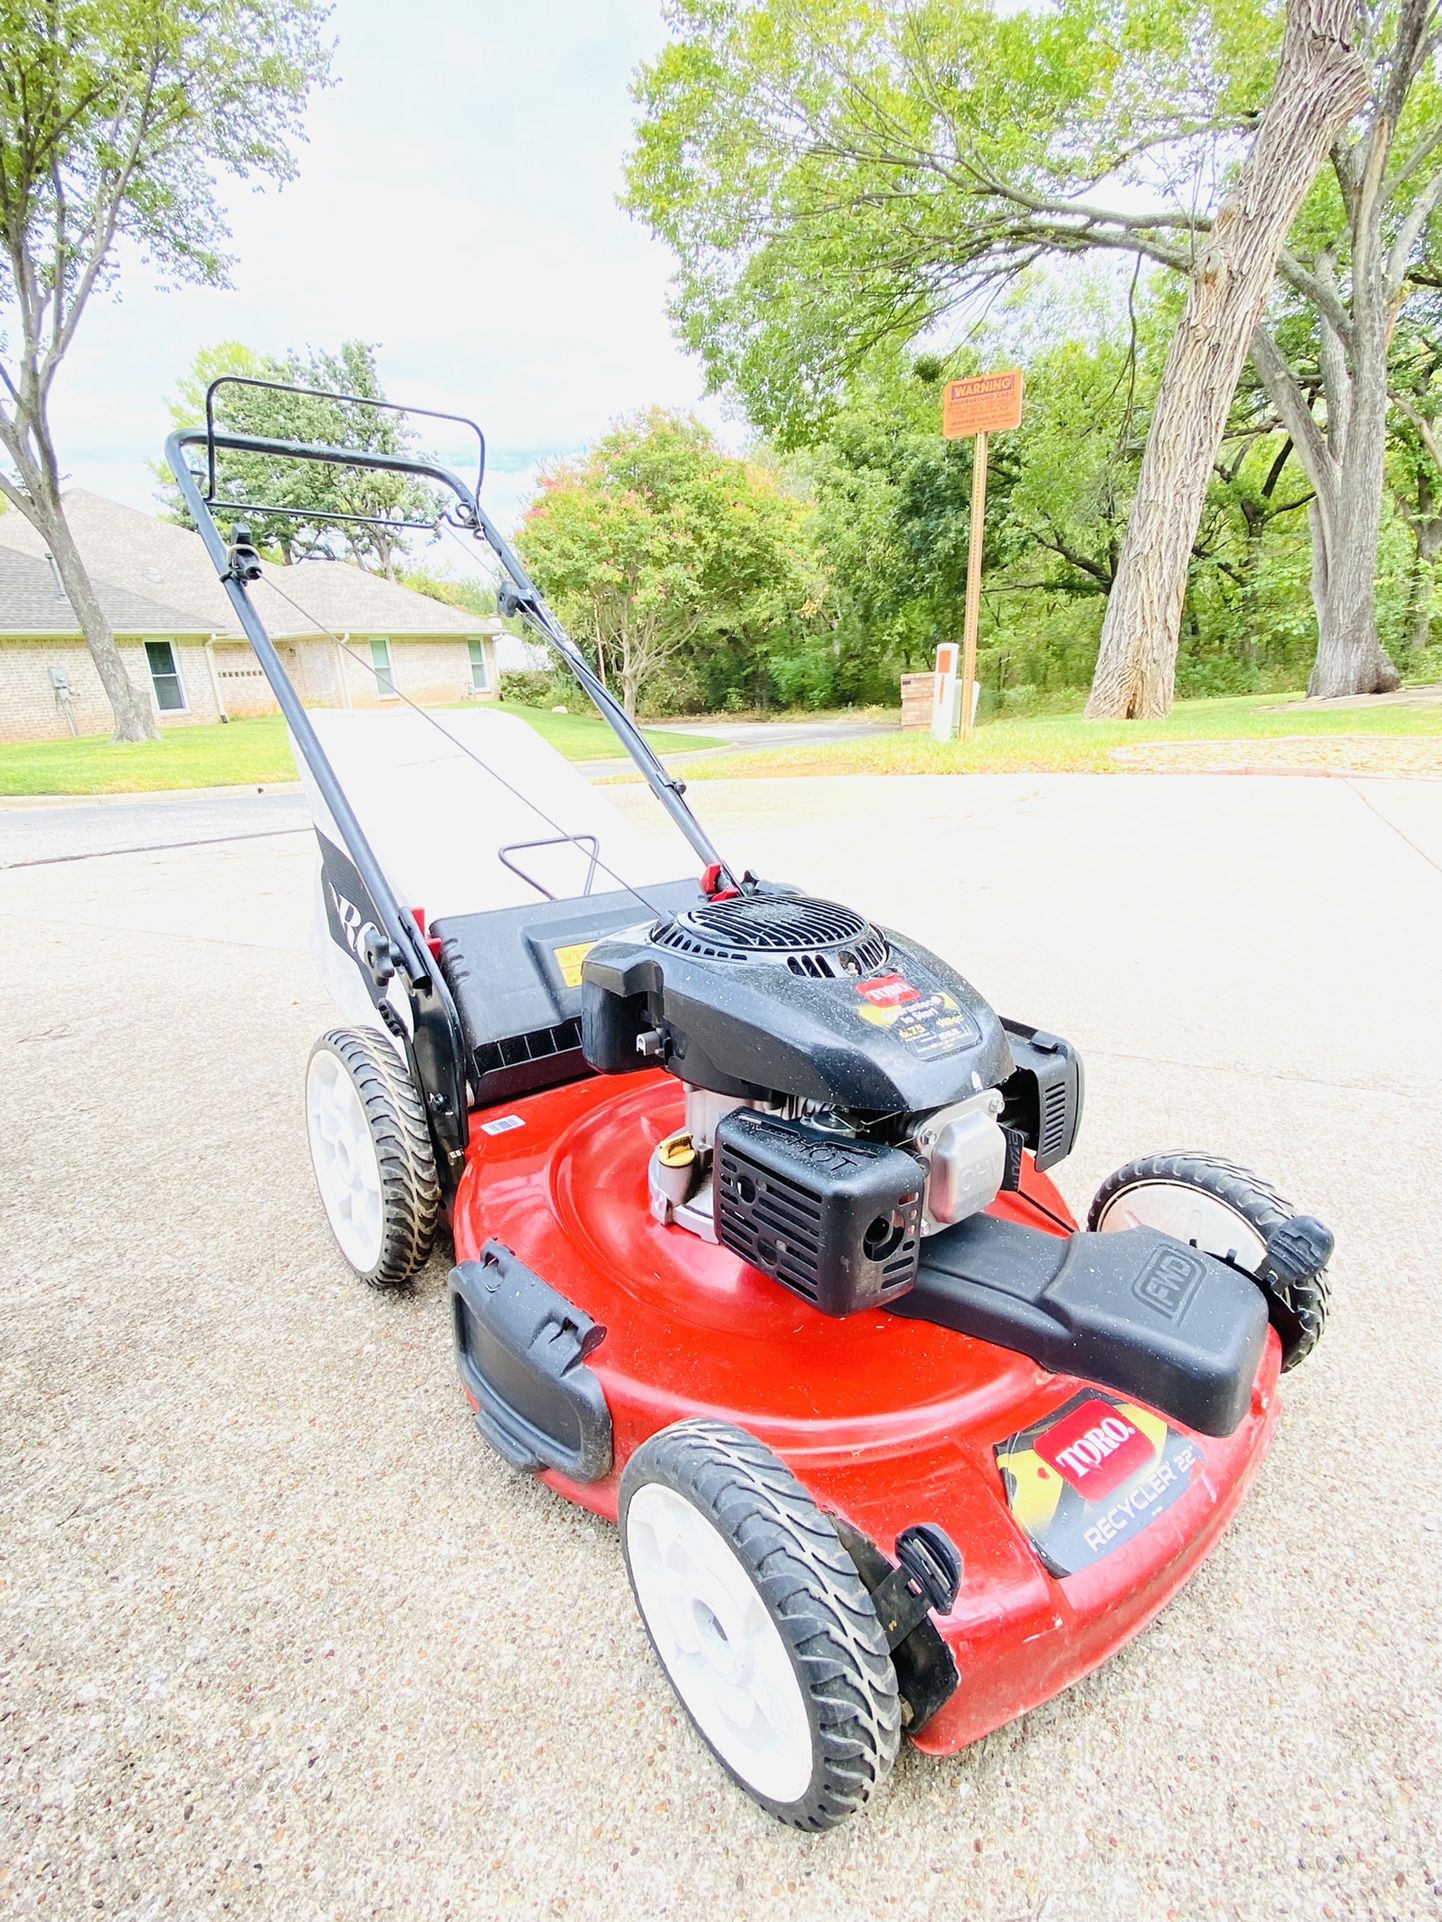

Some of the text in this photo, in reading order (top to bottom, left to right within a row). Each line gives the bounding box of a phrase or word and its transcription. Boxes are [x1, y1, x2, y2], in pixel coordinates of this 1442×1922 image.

[955, 378, 1011, 397] WARNING
[1145, 1255, 1192, 1306] FWD
[1056, 1417, 1131, 1478] TORO
[1083, 1464, 1178, 1552] RECYCLER
